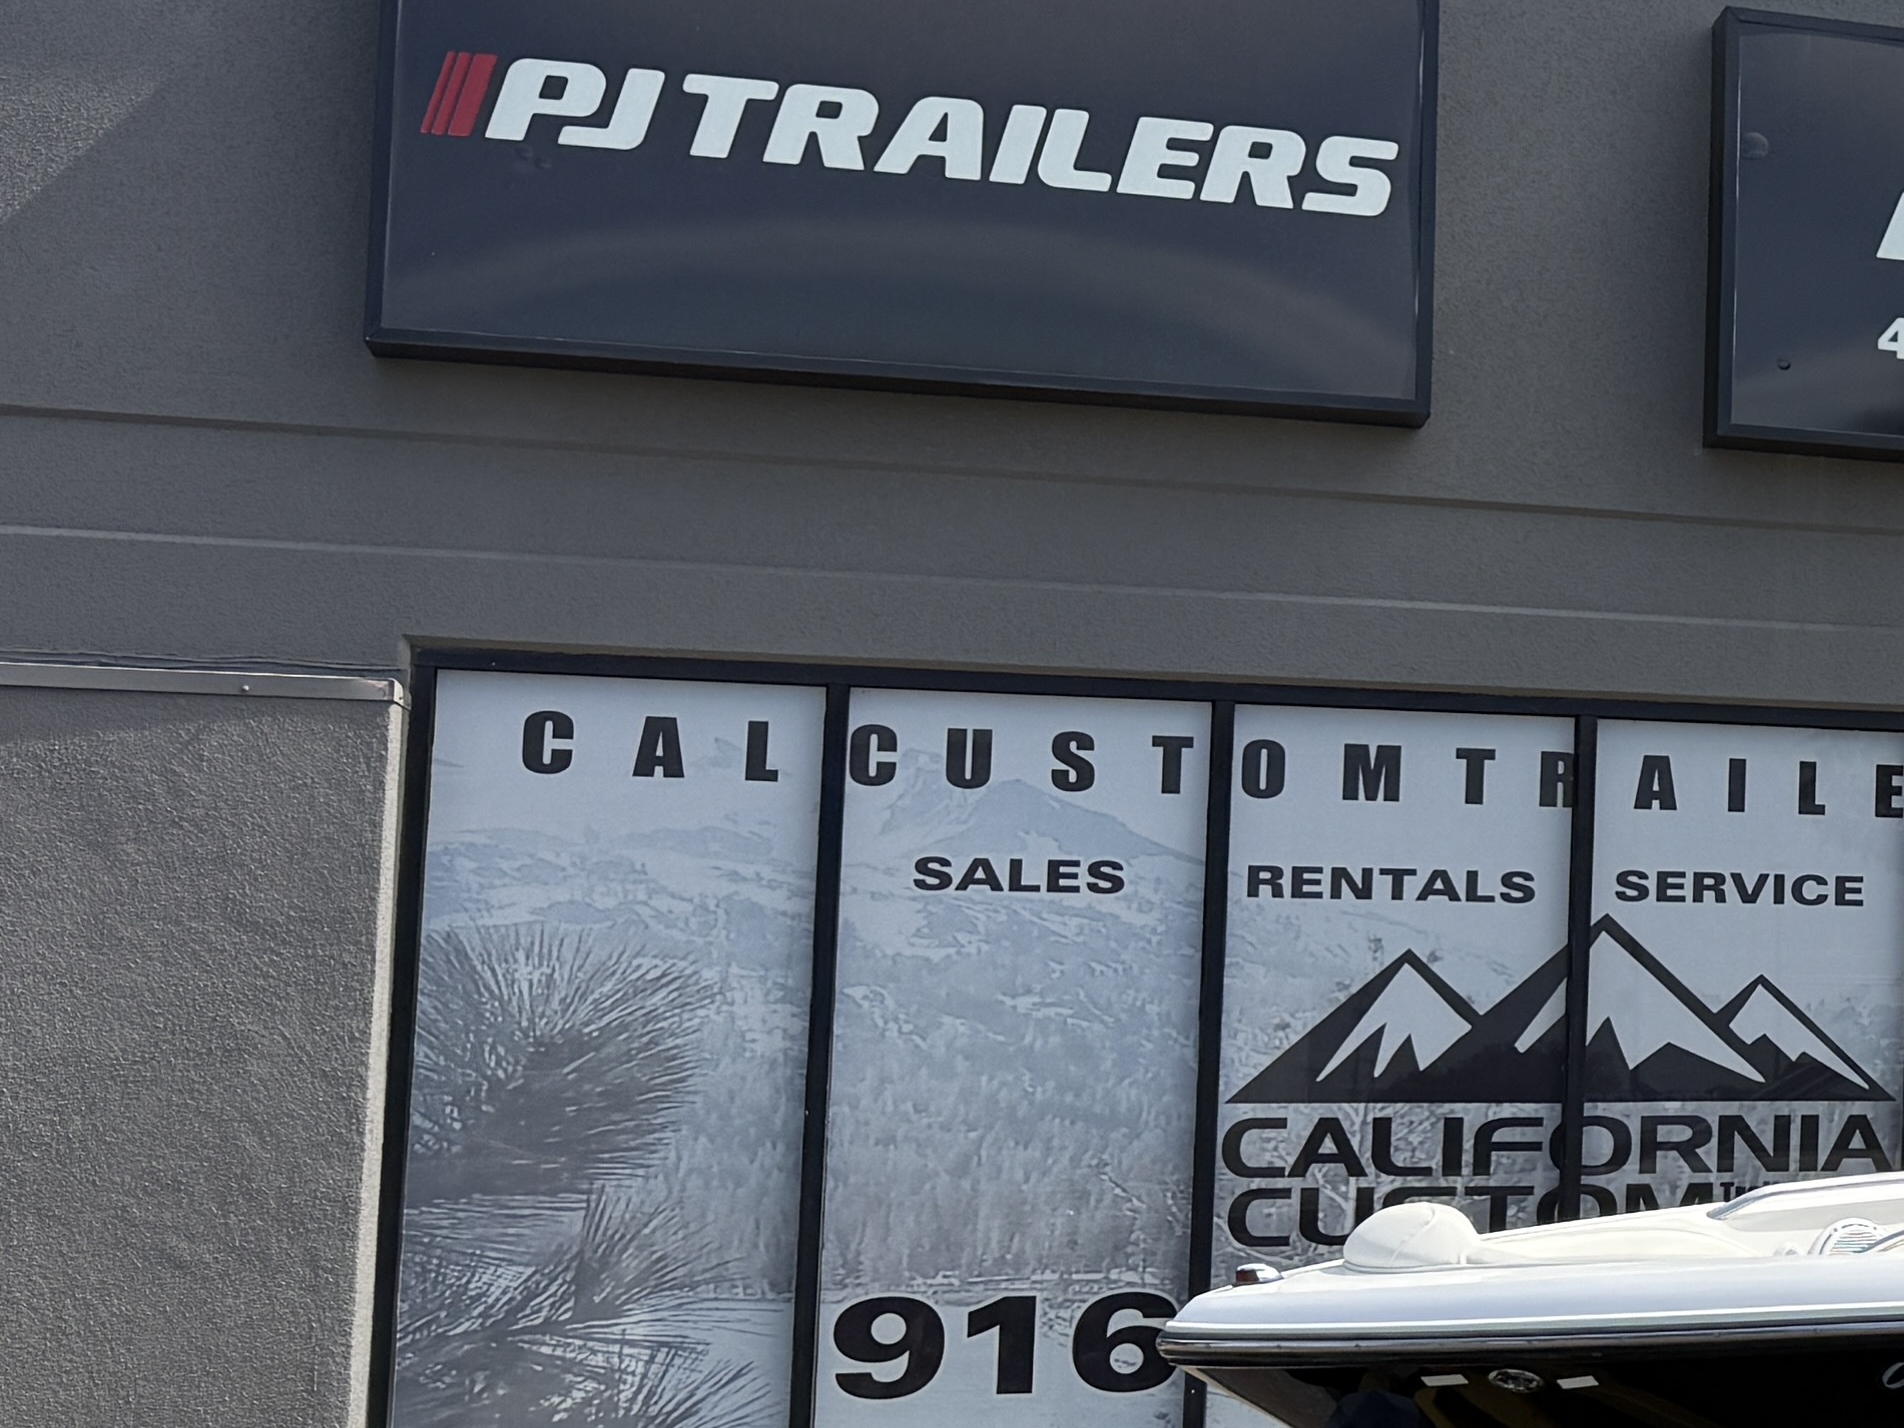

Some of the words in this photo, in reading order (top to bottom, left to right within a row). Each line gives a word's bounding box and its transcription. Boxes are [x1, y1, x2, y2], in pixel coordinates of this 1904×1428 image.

[485, 58, 666, 150] PJ
[682, 73, 1399, 217] TRAILERS
[913, 856, 1126, 895] SALES
[1247, 865, 1536, 904] RENTALS
[1615, 870, 1865, 907] SERVICE
[1221, 1114, 1895, 1179] CALIFORNIA
[833, 1290, 1168, 1401] 916
